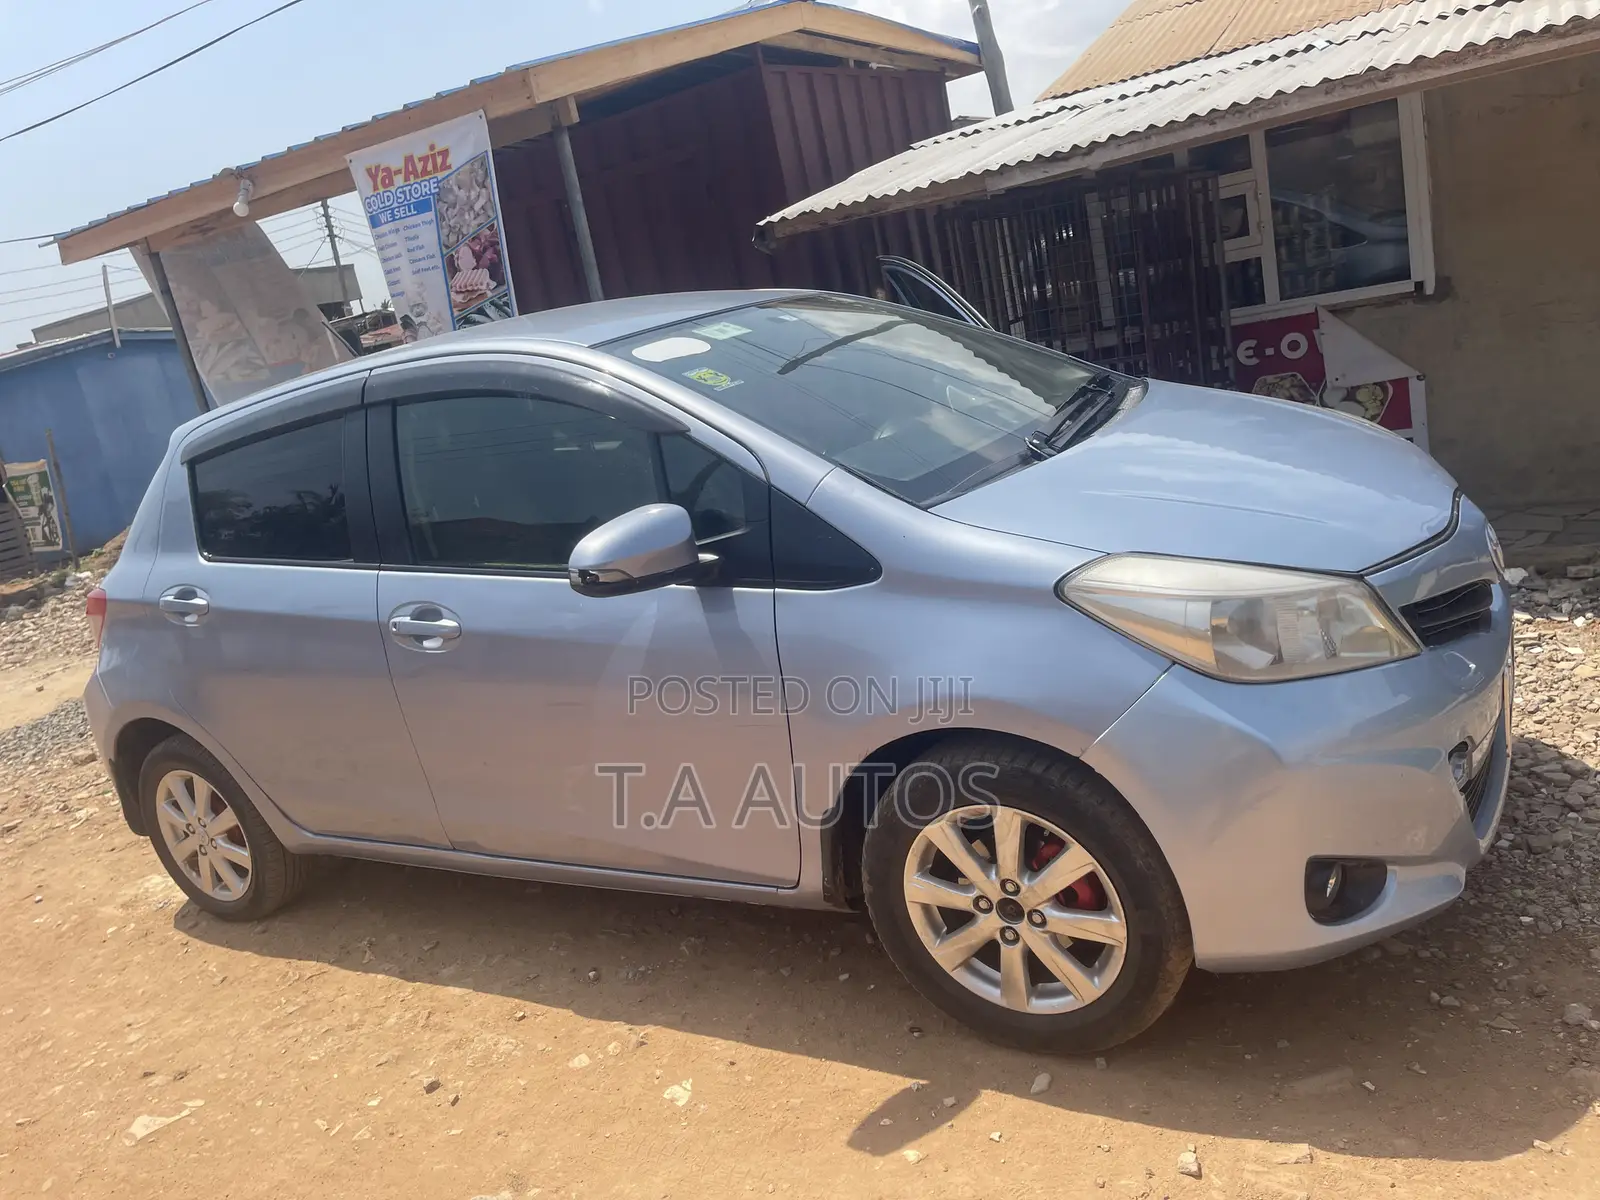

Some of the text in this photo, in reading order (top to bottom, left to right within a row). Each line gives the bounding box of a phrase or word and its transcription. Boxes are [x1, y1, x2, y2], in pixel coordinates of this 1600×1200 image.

[365, 143, 453, 193] Ya-Aziz
[364, 176, 440, 214] COLD STORE
[379, 203, 417, 224] WE SELL
